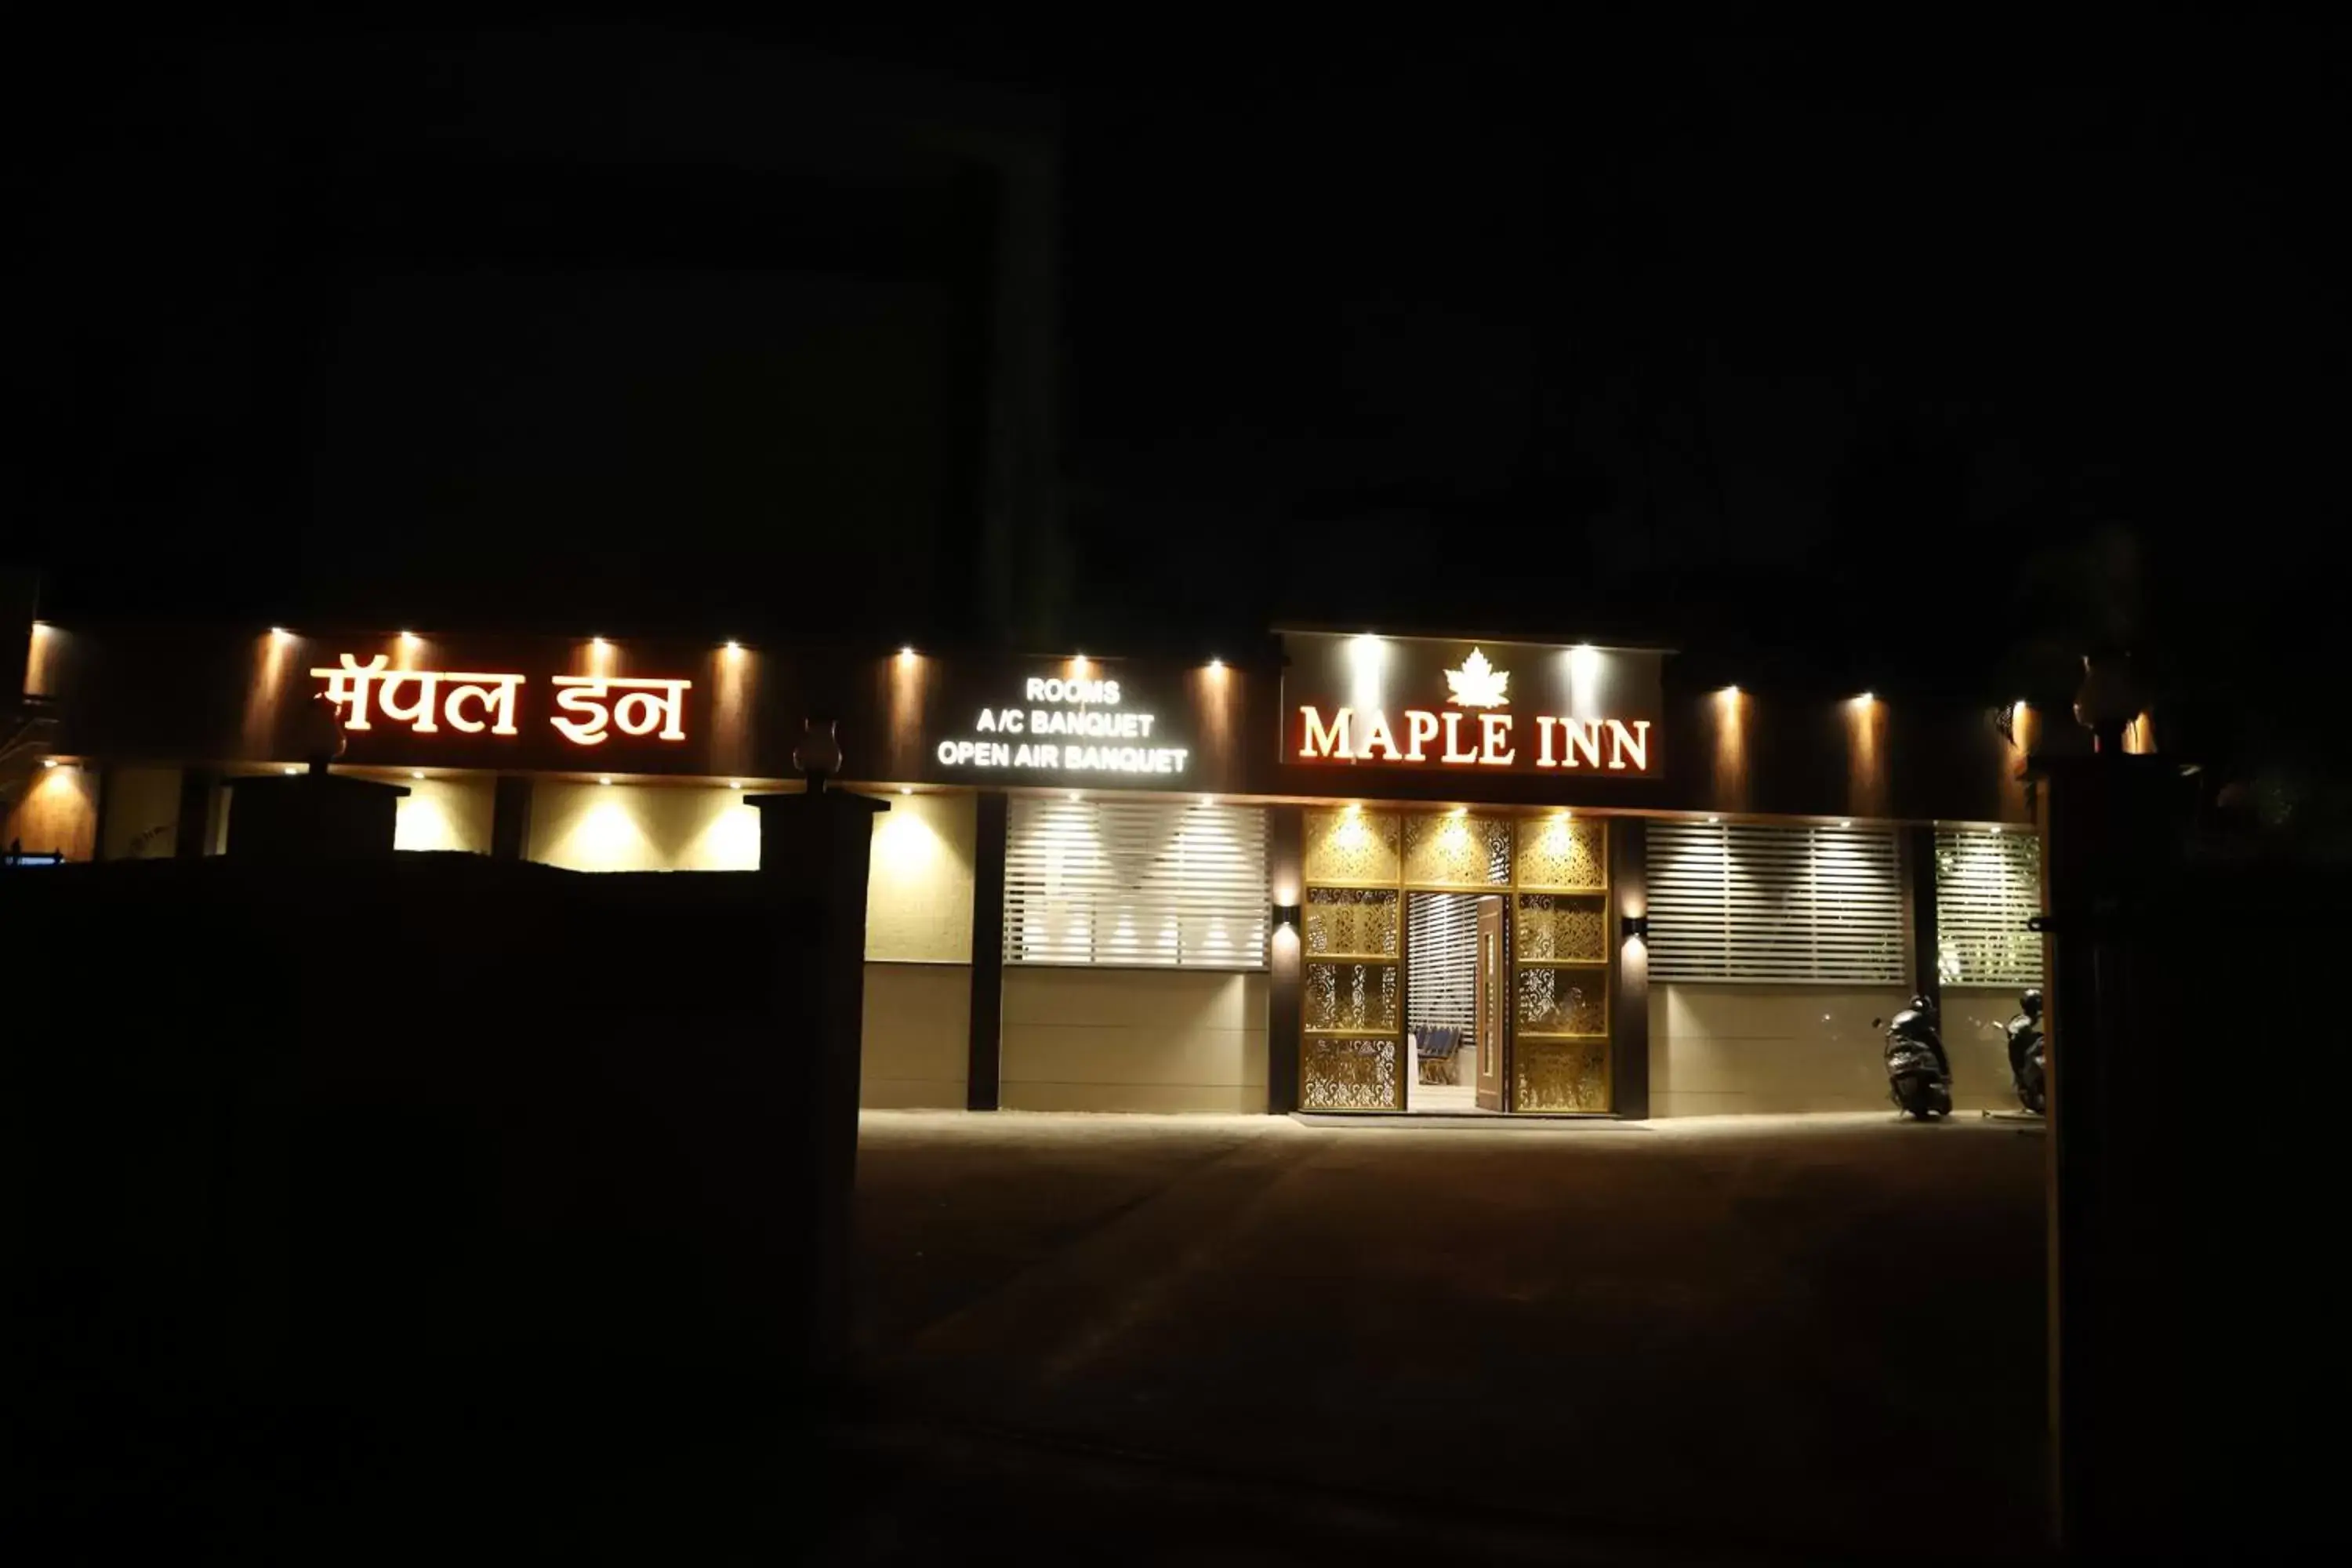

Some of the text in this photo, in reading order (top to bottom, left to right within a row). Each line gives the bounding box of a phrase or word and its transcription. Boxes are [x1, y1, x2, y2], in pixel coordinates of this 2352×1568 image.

[1026, 677, 1120, 704] ROOMS
[550, 675, 691, 745] इन
[976, 709, 1154, 738] A/C BANQUET
[1300, 706, 1650, 771] MAPLE INN
[938, 741, 1188, 772] OPEN AIR BANQUET
